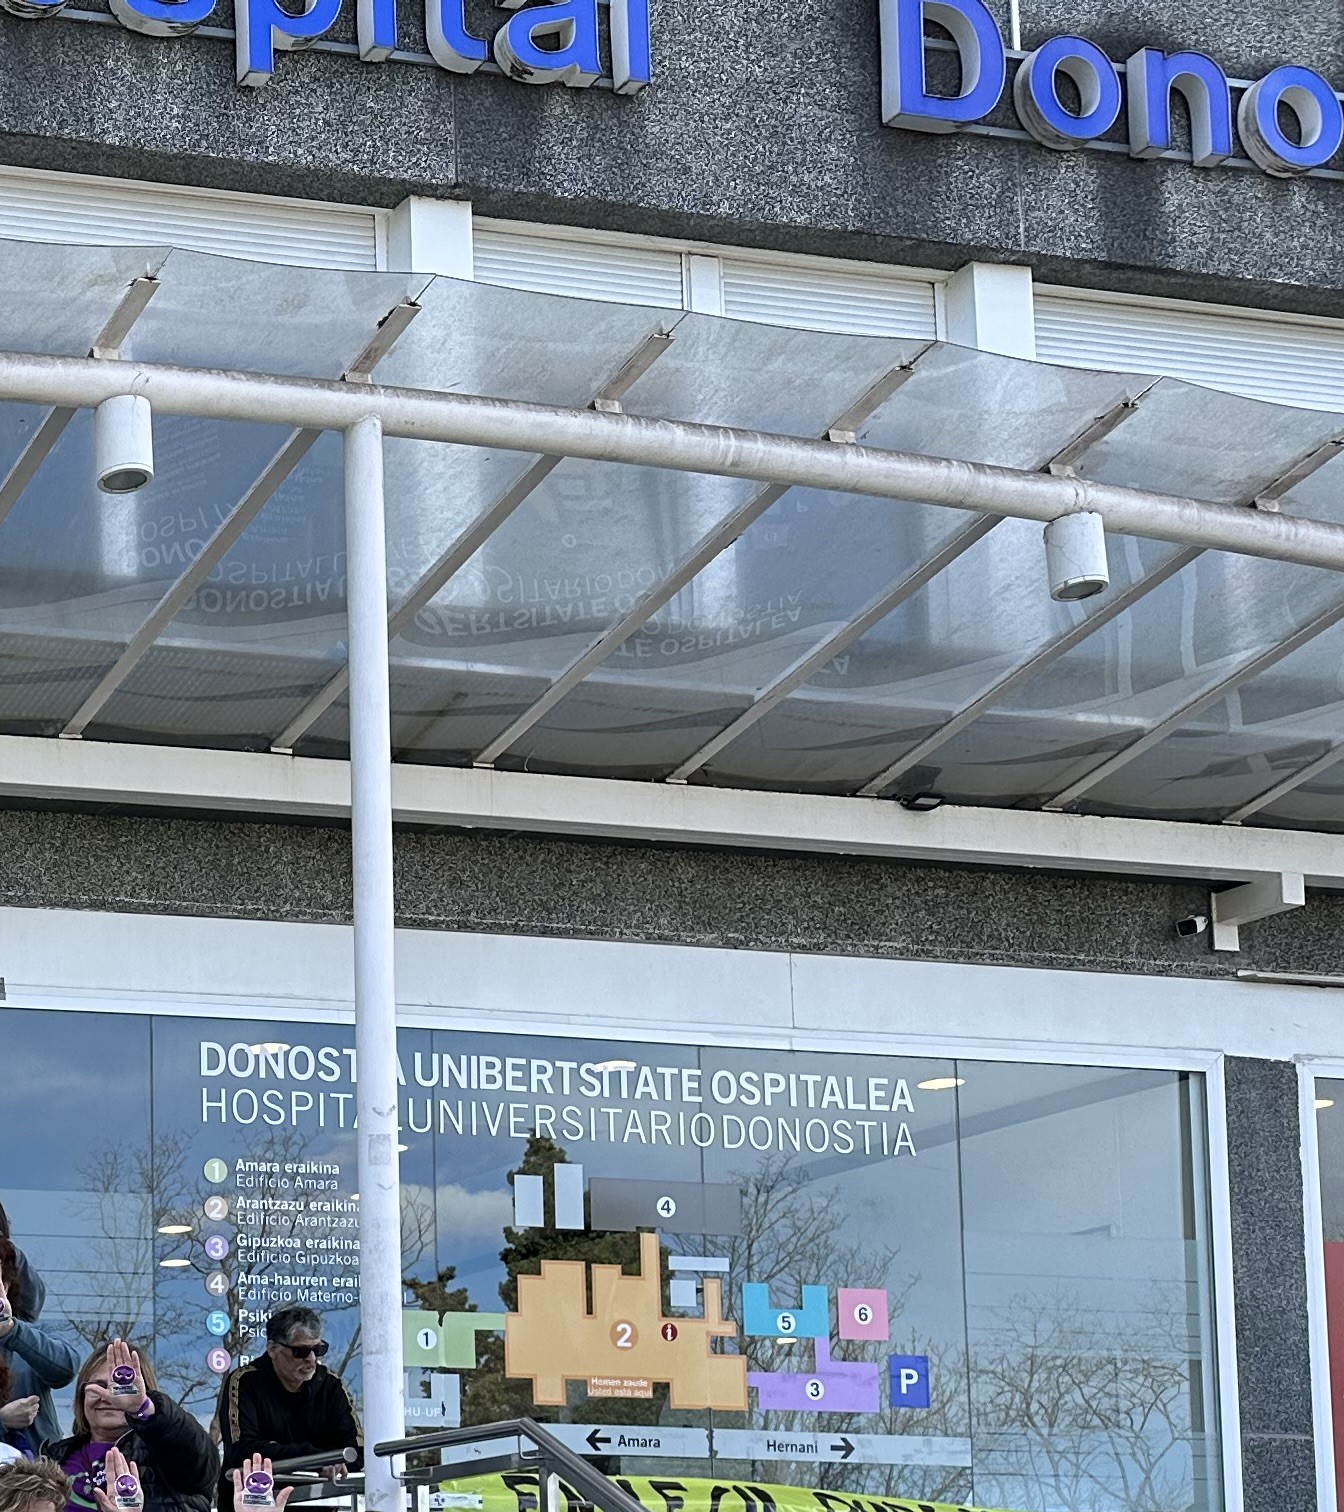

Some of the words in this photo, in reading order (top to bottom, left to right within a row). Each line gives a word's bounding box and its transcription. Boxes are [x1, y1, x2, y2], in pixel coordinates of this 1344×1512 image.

[200, 1041, 406, 1086] DONOST
[414, 1052, 703, 1104] UNIBERTSITATE
[712, 1069, 915, 1113] OSPITALEA
[201, 1087, 403, 1132] HOSPIT
[408, 1098, 715, 1148] UNIVERSITARIO
[722, 1114, 917, 1157] DONOSTIA
[212, 1162, 220, 1180] 1
[236, 1159, 279, 1173] Amara
[285, 1159, 340, 1174] eraikina
[236, 1174, 289, 1189] Edificio
[294, 1176, 338, 1190] Amara
[209, 1200, 223, 1219] 2
[236, 1197, 304, 1211] Arantzazu
[310, 1198, 359, 1213] eraikin
[660, 1200, 671, 1214] 4
[237, 1212, 290, 1226] Edificio
[210, 1238, 223, 1257] 3
[236, 1234, 301, 1251] Gipuzkoa
[306, 1236, 360, 1250] eraikina
[237, 1250, 290, 1264] Edificio
[295, 1251, 359, 1268] Gipuzkoa
[210, 1274, 224, 1293] 4
[238, 1272, 328, 1288] Ama-haurren
[238, 1288, 292, 1301] Edificio
[213, 1314, 225, 1332] 5
[858, 1307, 868, 1321] 6
[616, 1324, 632, 1347] 2
[782, 1316, 791, 1330] 5
[213, 1351, 225, 1370] 6
[810, 1383, 820, 1397] 3
[900, 1368, 919, 1394] P
[617, 1435, 661, 1448] Amara
[767, 1440, 818, 1455] Hernani
